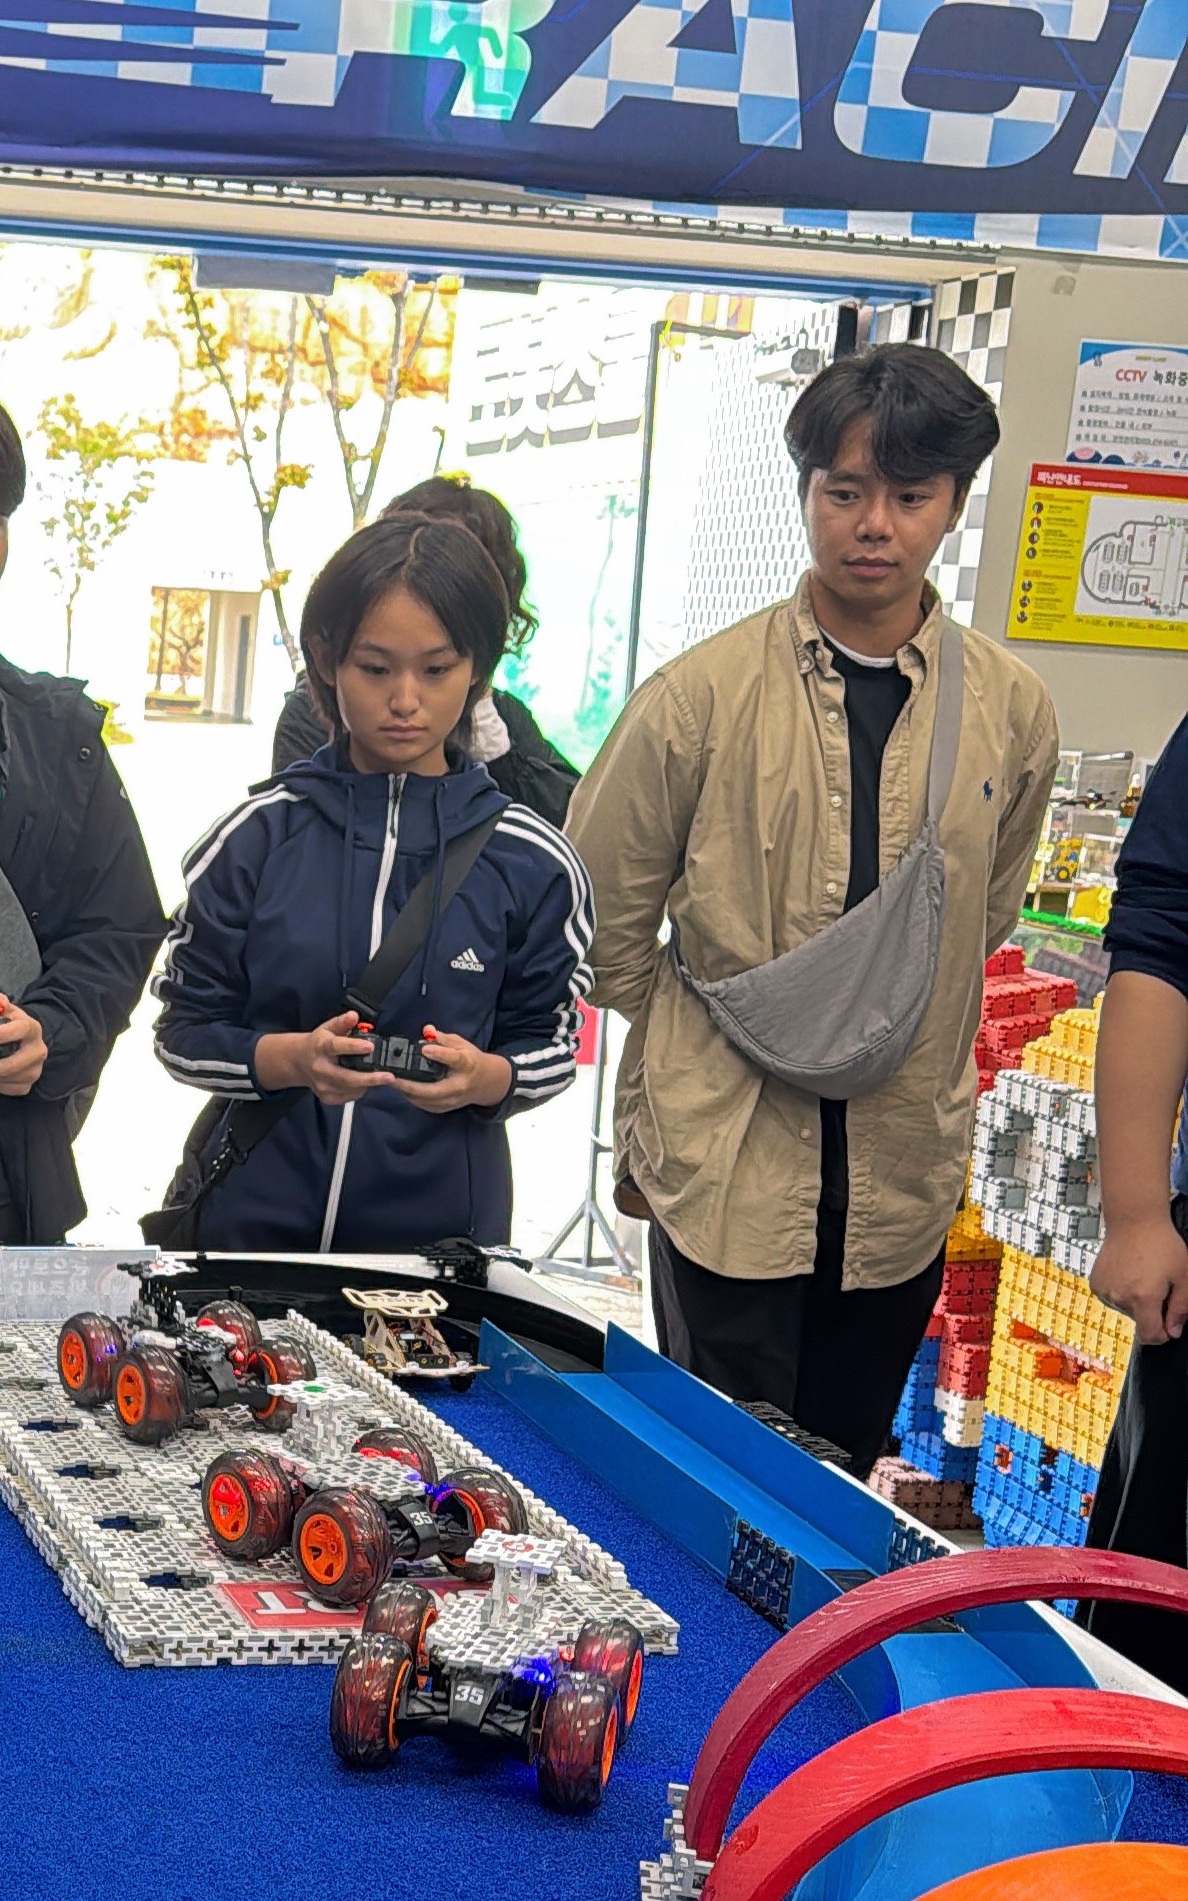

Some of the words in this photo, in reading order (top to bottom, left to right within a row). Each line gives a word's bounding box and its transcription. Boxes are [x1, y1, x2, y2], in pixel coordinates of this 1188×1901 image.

[252, 0, 1188, 184] RACI
[1115, 368, 1148, 382] CCTV
[451, 960, 485, 972] adidas
[410, 1511, 433, 1526] 35
[455, 1685, 485, 1705] 35
